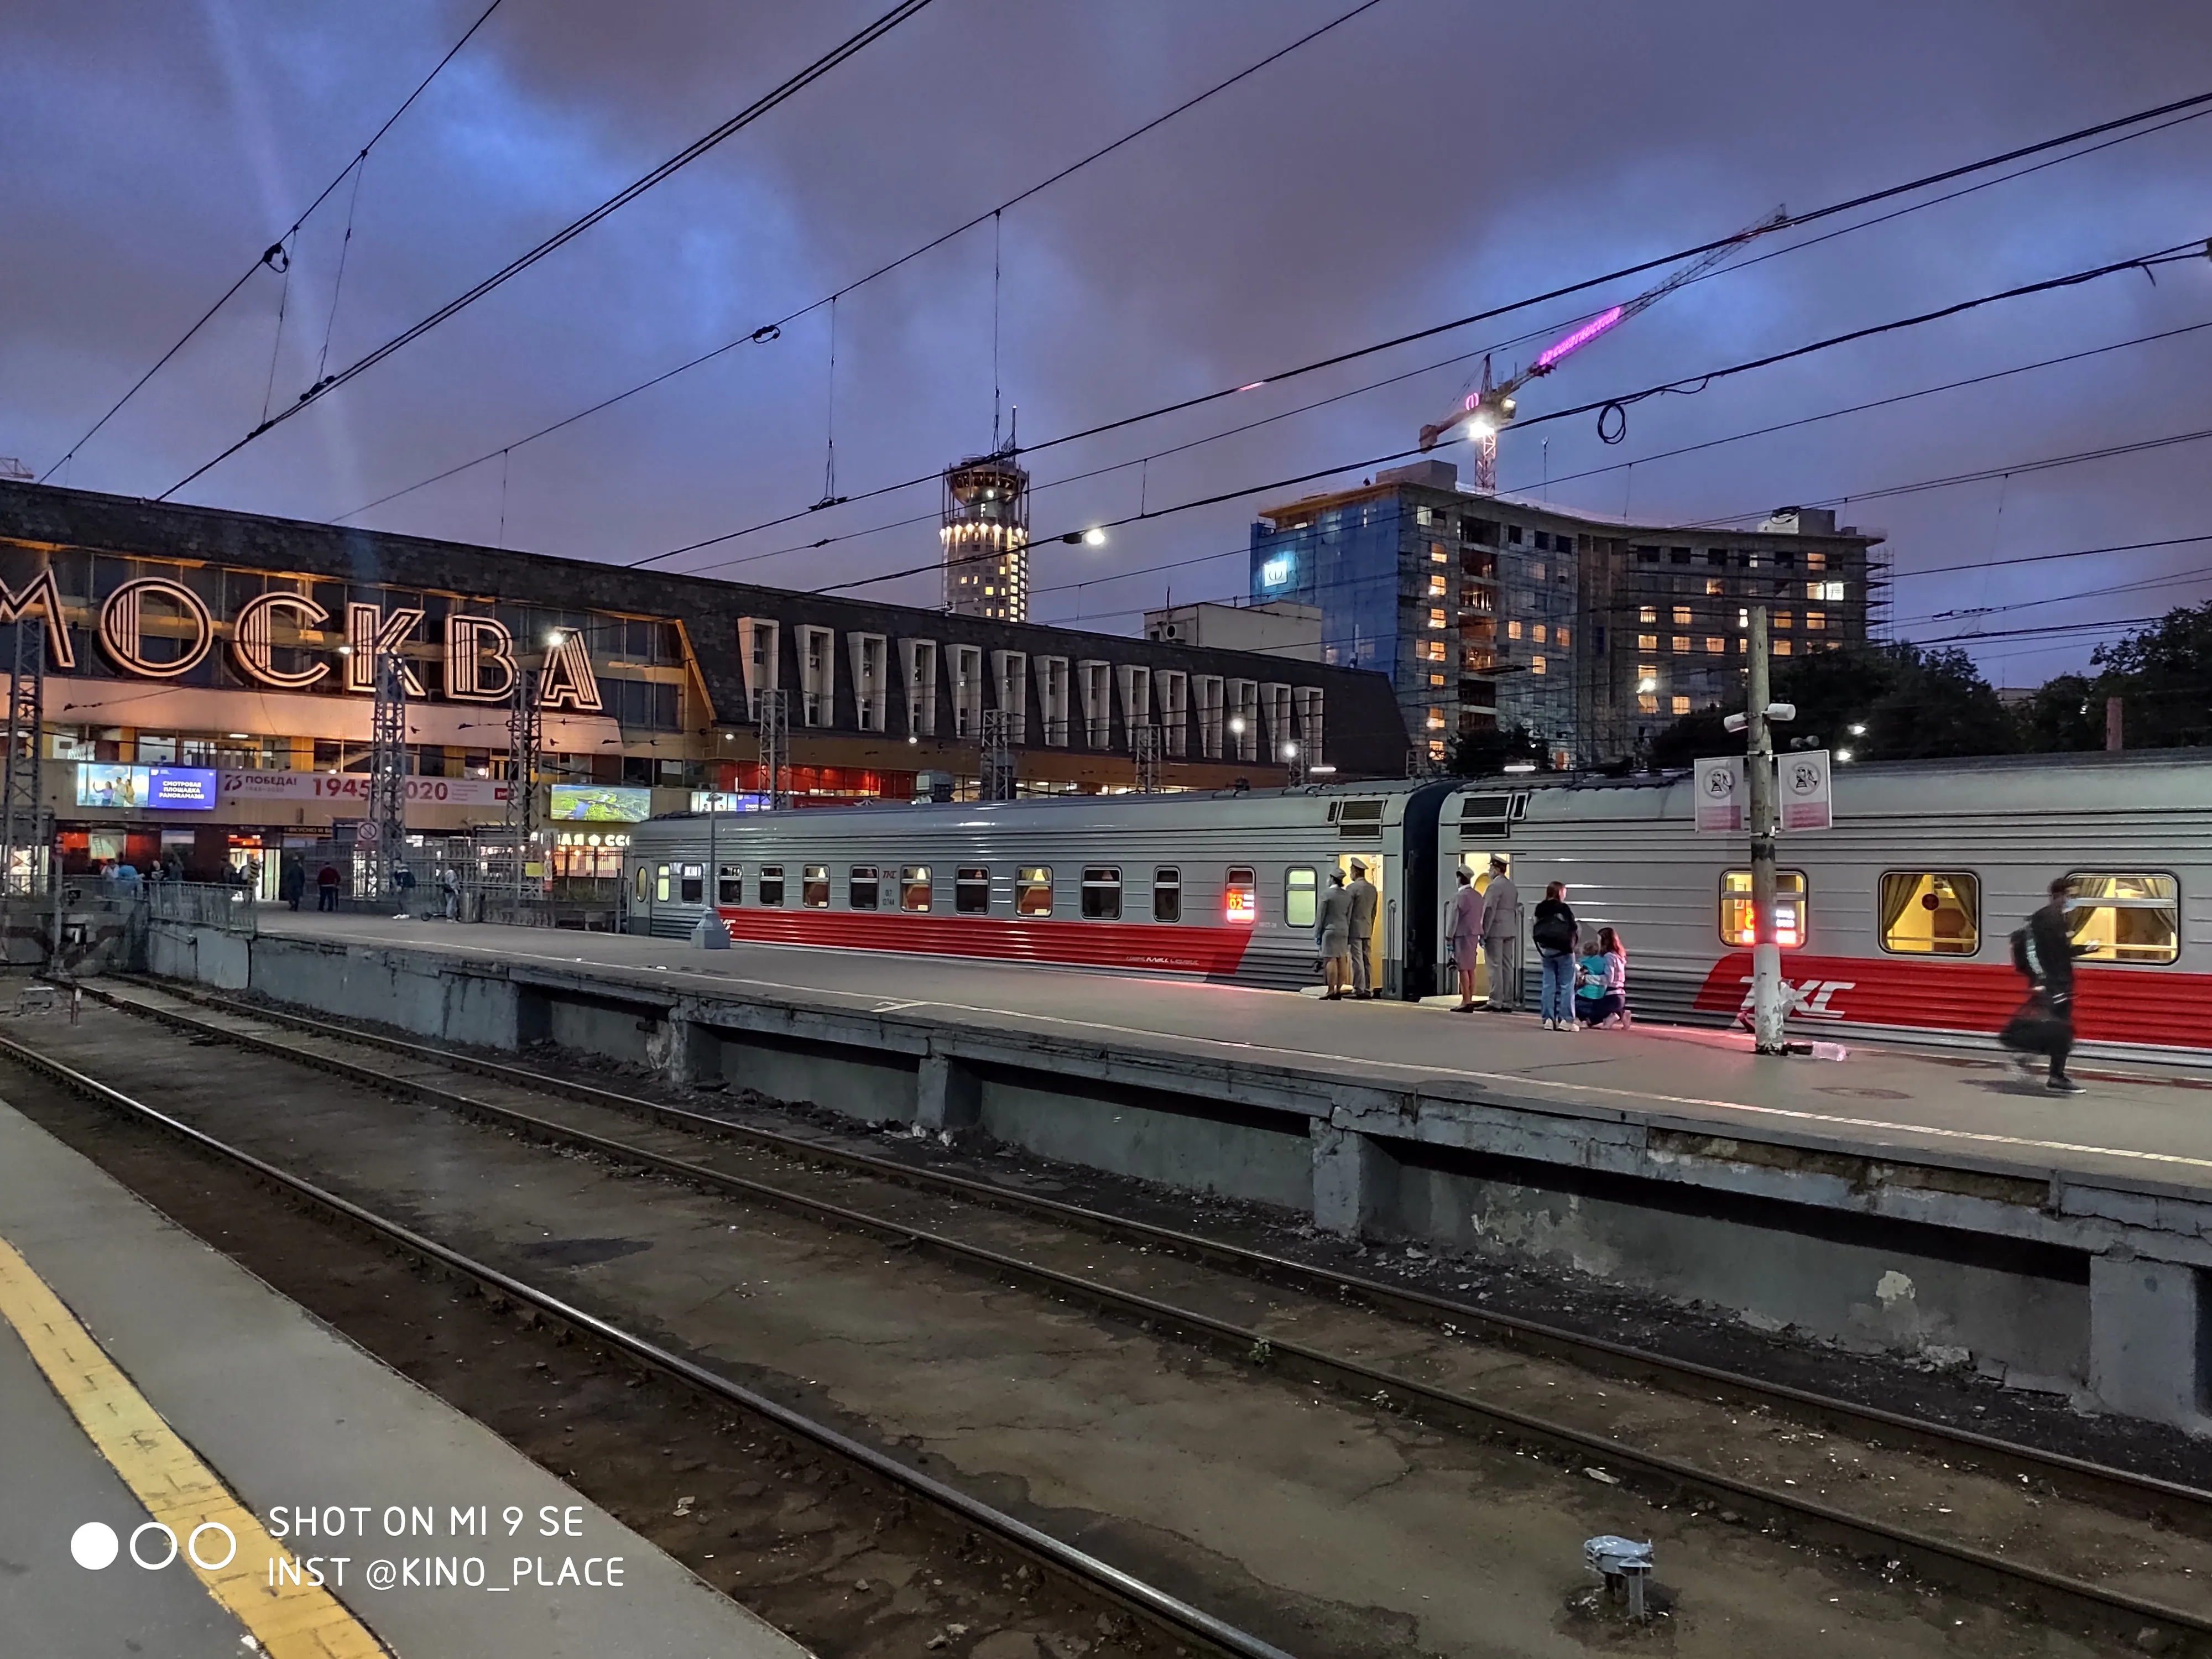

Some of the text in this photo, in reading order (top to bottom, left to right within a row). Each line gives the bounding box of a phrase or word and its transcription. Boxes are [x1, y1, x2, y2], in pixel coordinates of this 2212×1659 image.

[1553, 307, 1620, 357] CONSTRUCTION
[0, 565, 603, 711] МОСКВА
[246, 775, 297, 786] ПОБЕДА!
[1229, 898, 1243, 910] 02
